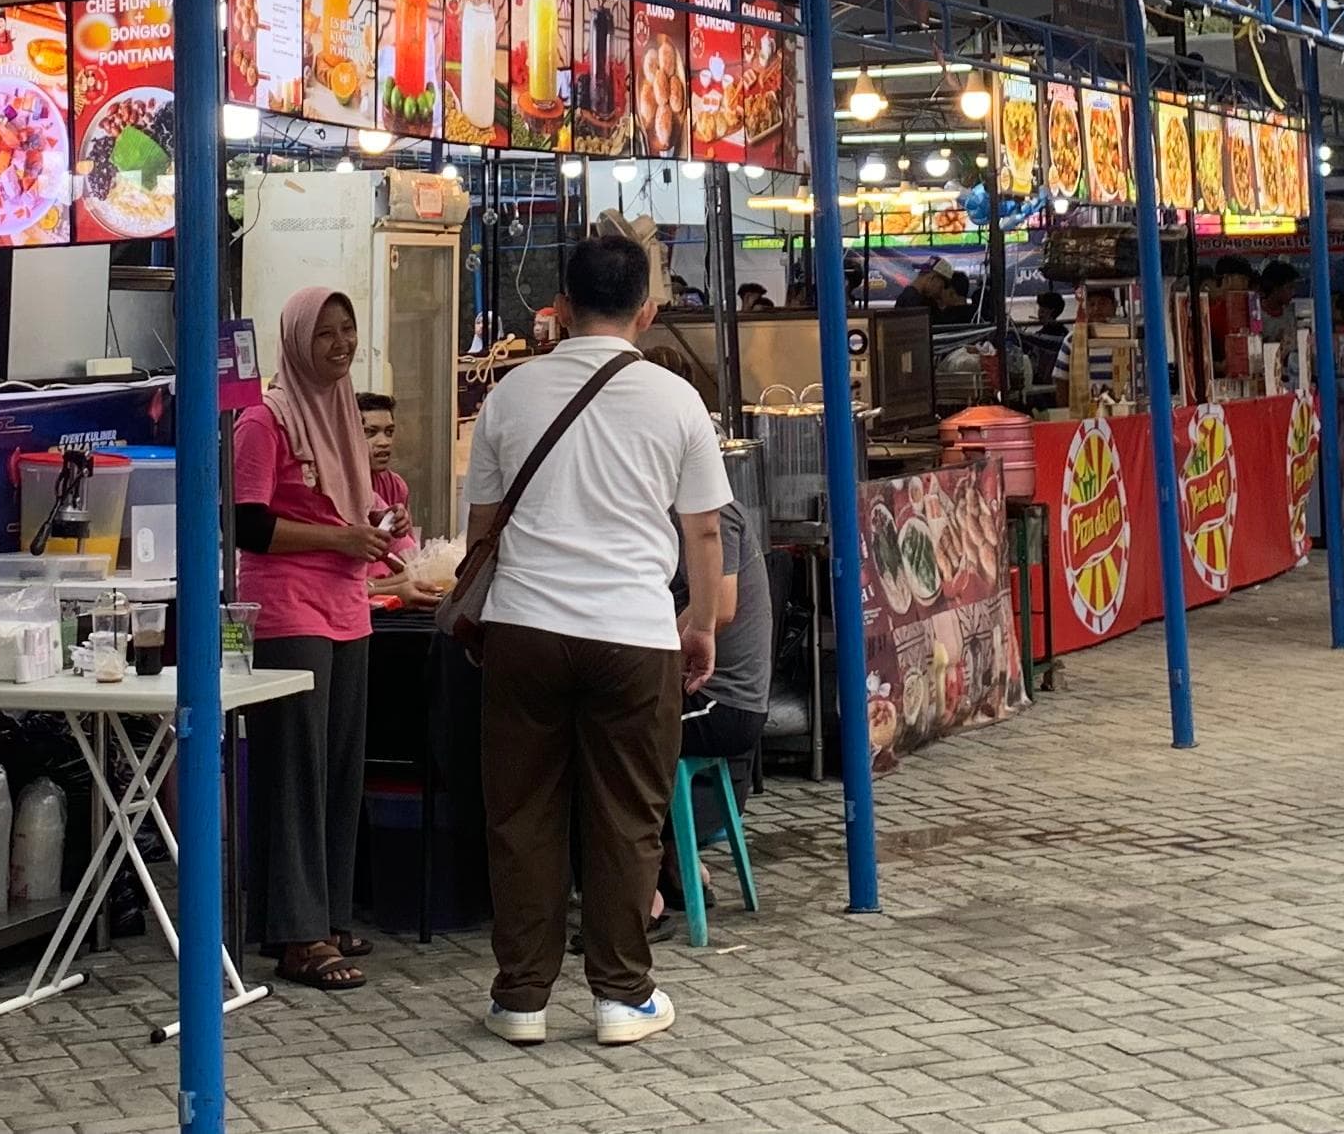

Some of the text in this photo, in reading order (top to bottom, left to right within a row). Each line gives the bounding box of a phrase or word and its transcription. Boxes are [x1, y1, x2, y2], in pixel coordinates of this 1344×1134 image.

[741, 3, 756, 18] CHA
[110, 23, 171, 42] BONGKO
[99, 46, 174, 66] PONTIANA
[59, 430, 117, 444] EVENT KULINER
